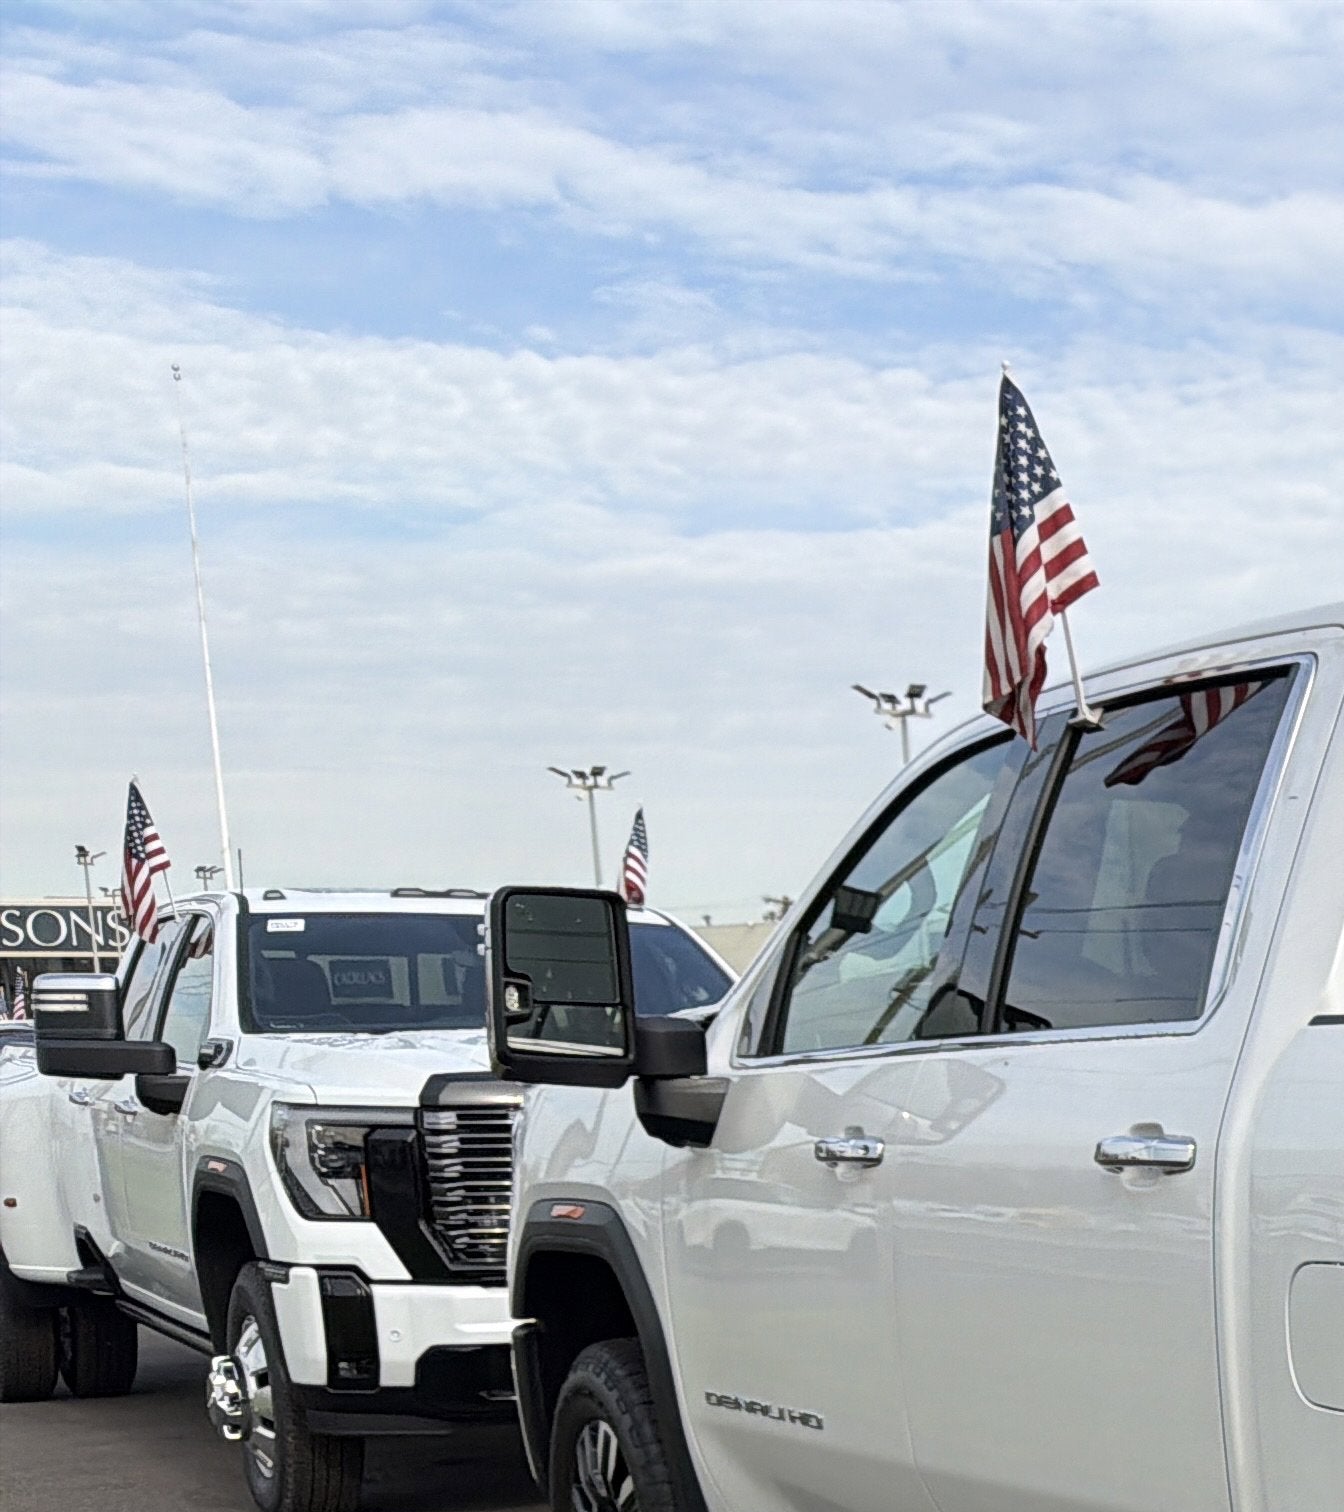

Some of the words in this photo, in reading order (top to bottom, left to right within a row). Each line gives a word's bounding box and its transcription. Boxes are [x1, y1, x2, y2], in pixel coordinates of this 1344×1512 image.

[1, 909, 130, 947] SONS
[704, 1391, 785, 1422] DENALI
[787, 1408, 824, 1431] HD
